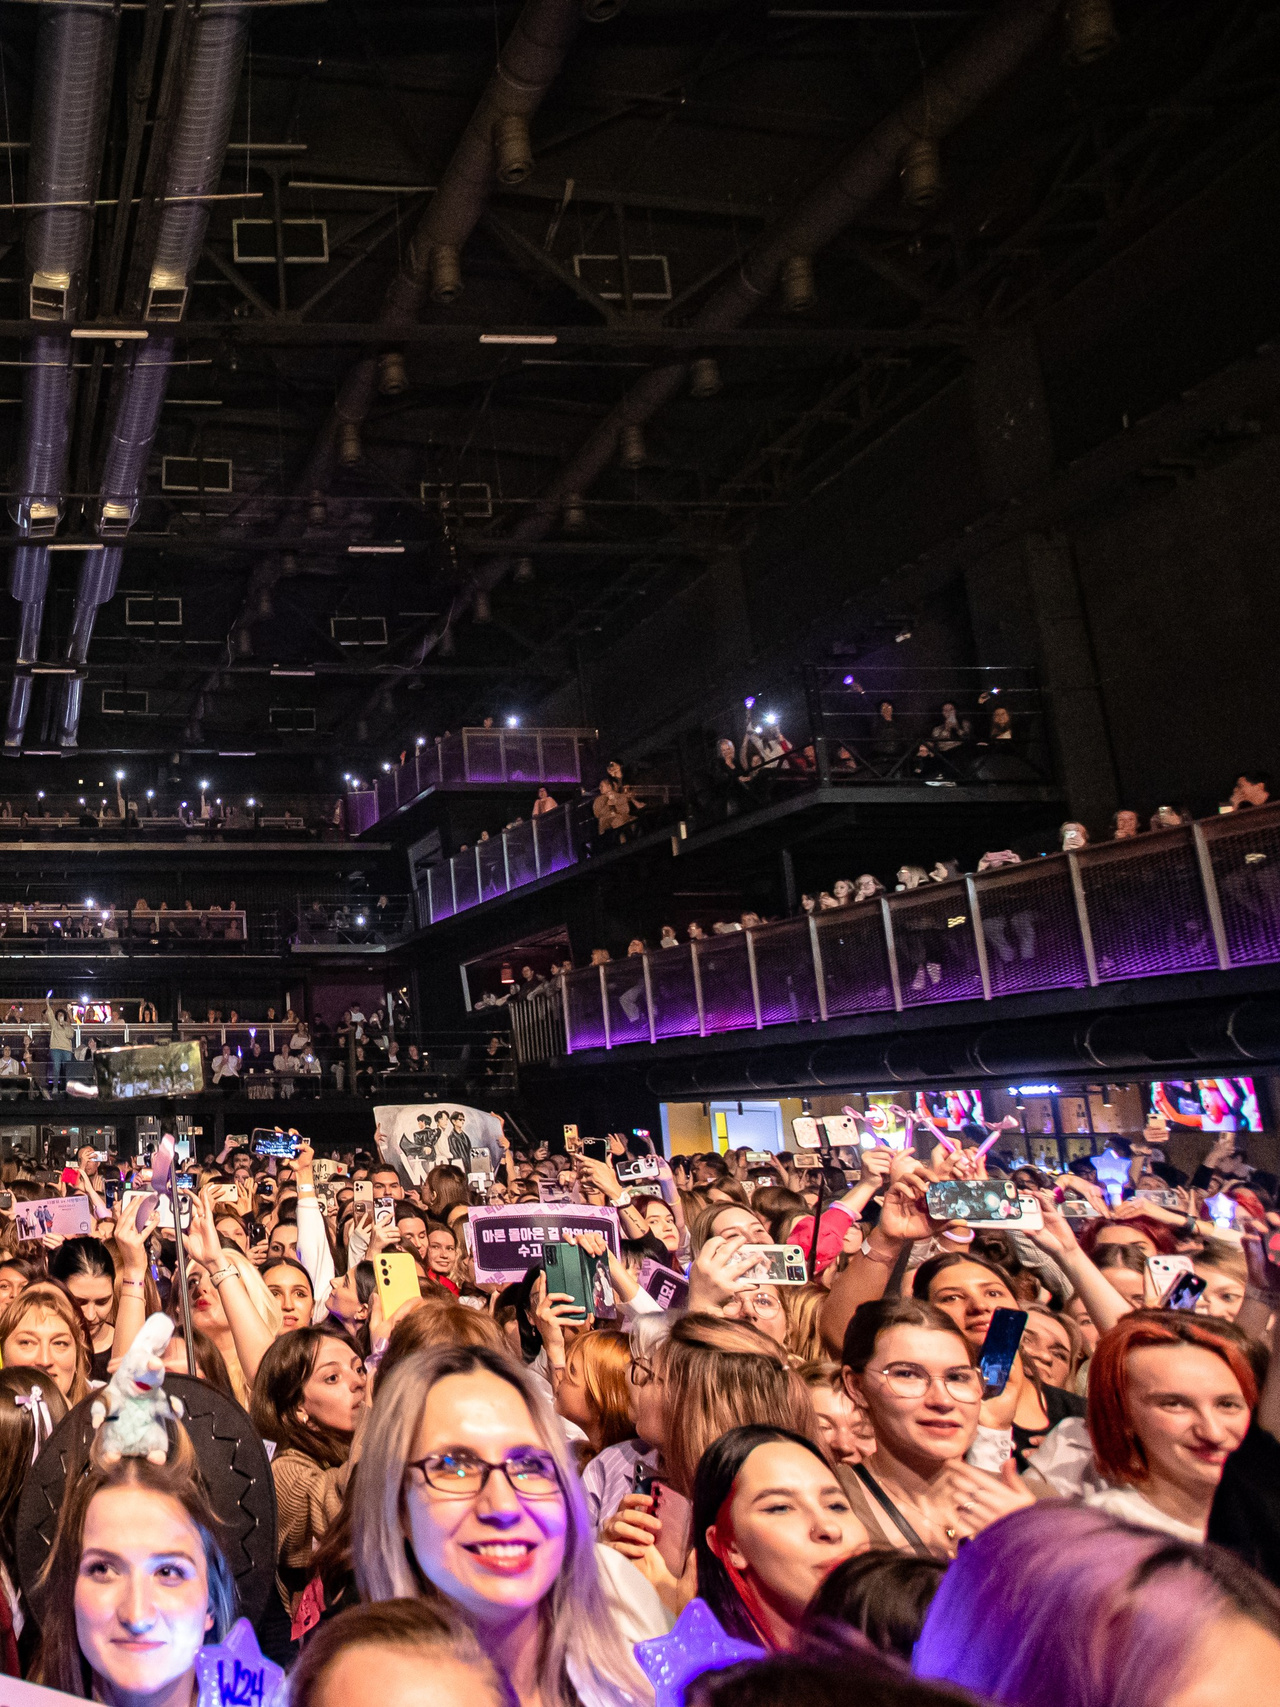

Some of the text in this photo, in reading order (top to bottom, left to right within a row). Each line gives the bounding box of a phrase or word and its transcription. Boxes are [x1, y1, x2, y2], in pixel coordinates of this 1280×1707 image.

[508, 1226, 545, 1242] 돌아온
[518, 1243, 543, 1258] 수고
[216, 1658, 265, 1707] W24
